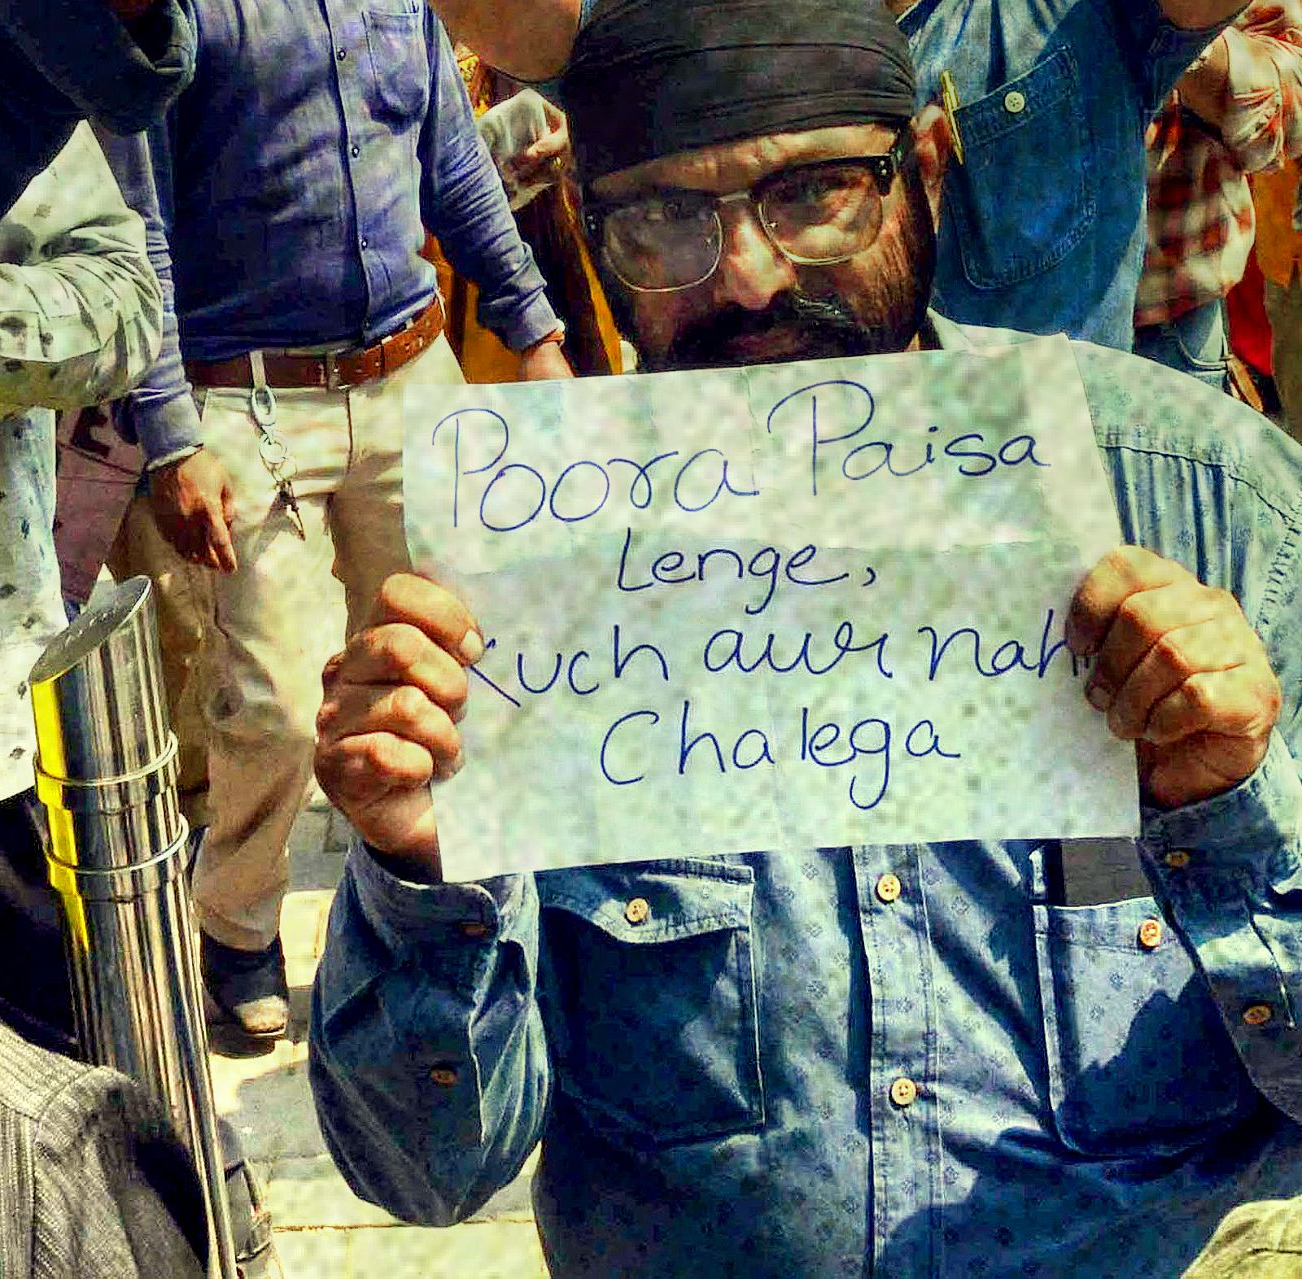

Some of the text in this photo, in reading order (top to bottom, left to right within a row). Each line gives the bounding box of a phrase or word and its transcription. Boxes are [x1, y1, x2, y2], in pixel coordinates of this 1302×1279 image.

[431, 378, 1052, 533] Poora Paisa
[702, 619, 894, 679] aur
[917, 608, 1091, 681] nah
[599, 699, 962, 811] Chalega
